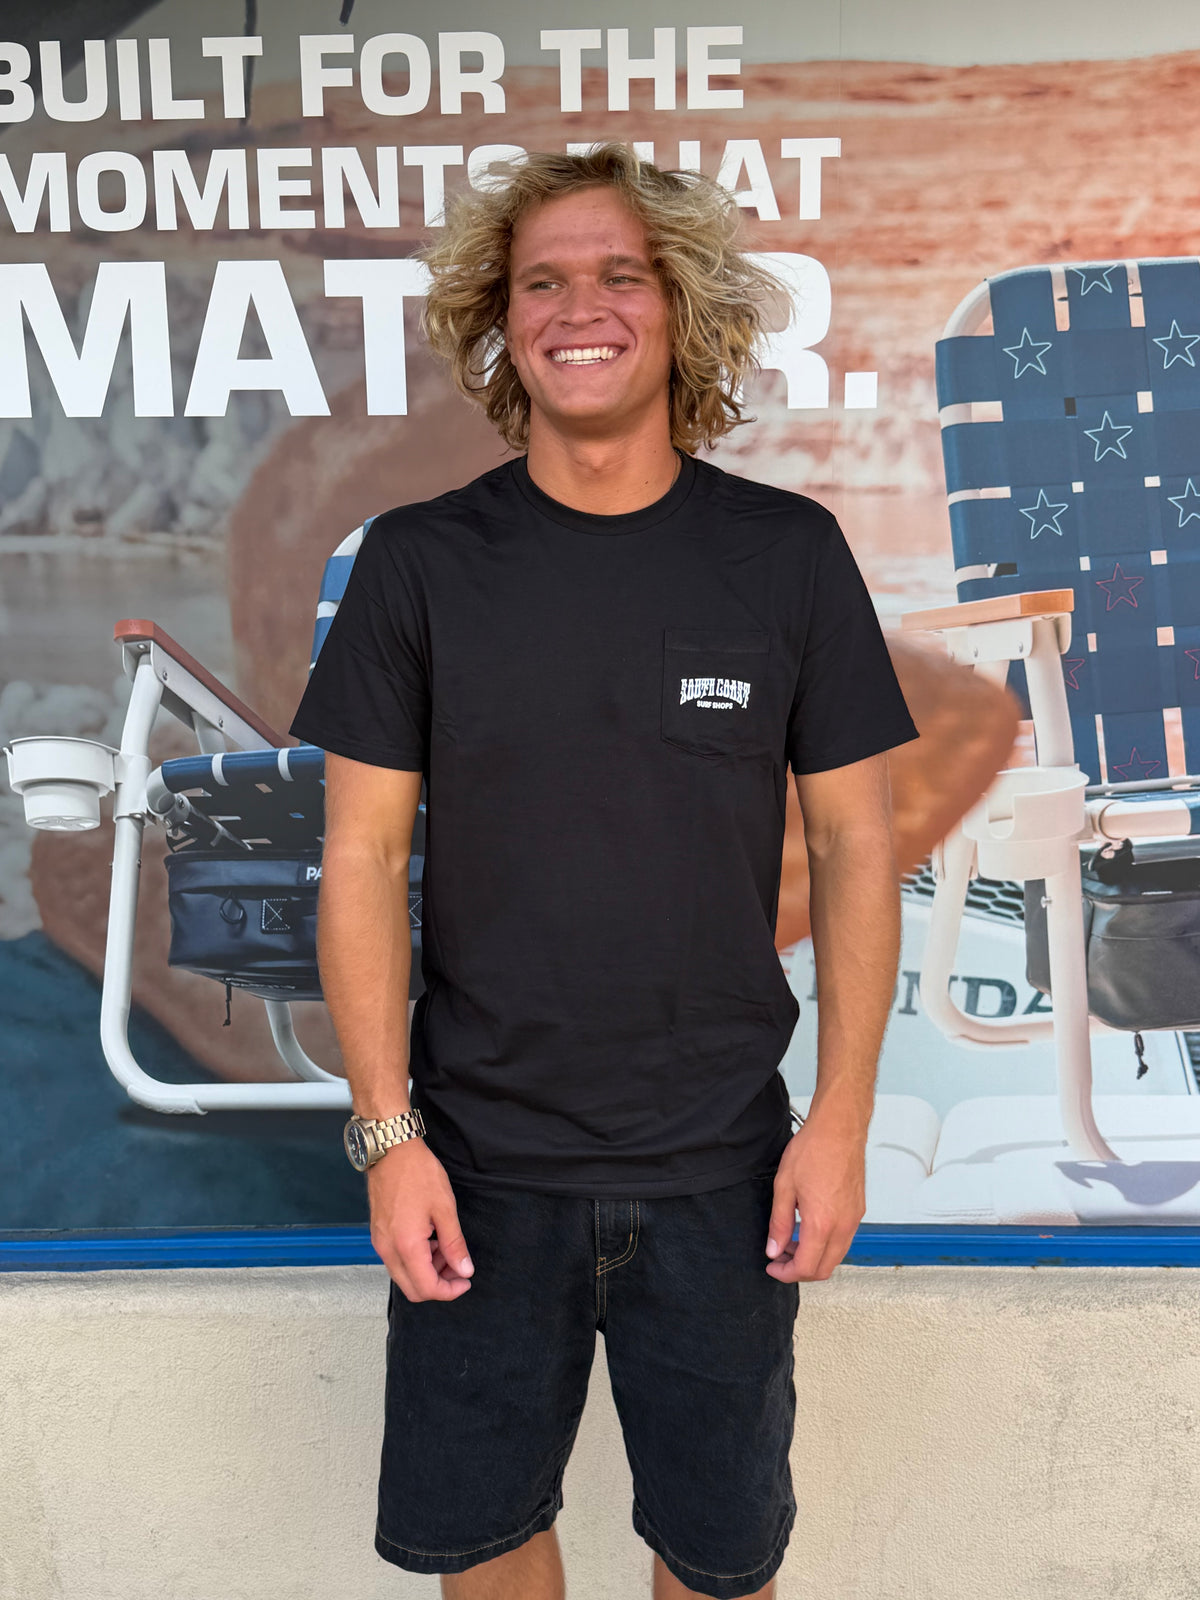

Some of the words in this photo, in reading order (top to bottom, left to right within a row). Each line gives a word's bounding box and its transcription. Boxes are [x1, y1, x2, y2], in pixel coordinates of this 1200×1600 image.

[0, 36, 263, 123] BUILT
[300, 32, 506, 117] FOR
[540, 26, 744, 112] THE
[0, 252, 878, 419] MATR.
[680, 678, 716, 705] SOUTH
[716, 679, 751, 709] COAST
[696, 700, 712, 708] SURF
[712, 701, 733, 709] SHOPS
